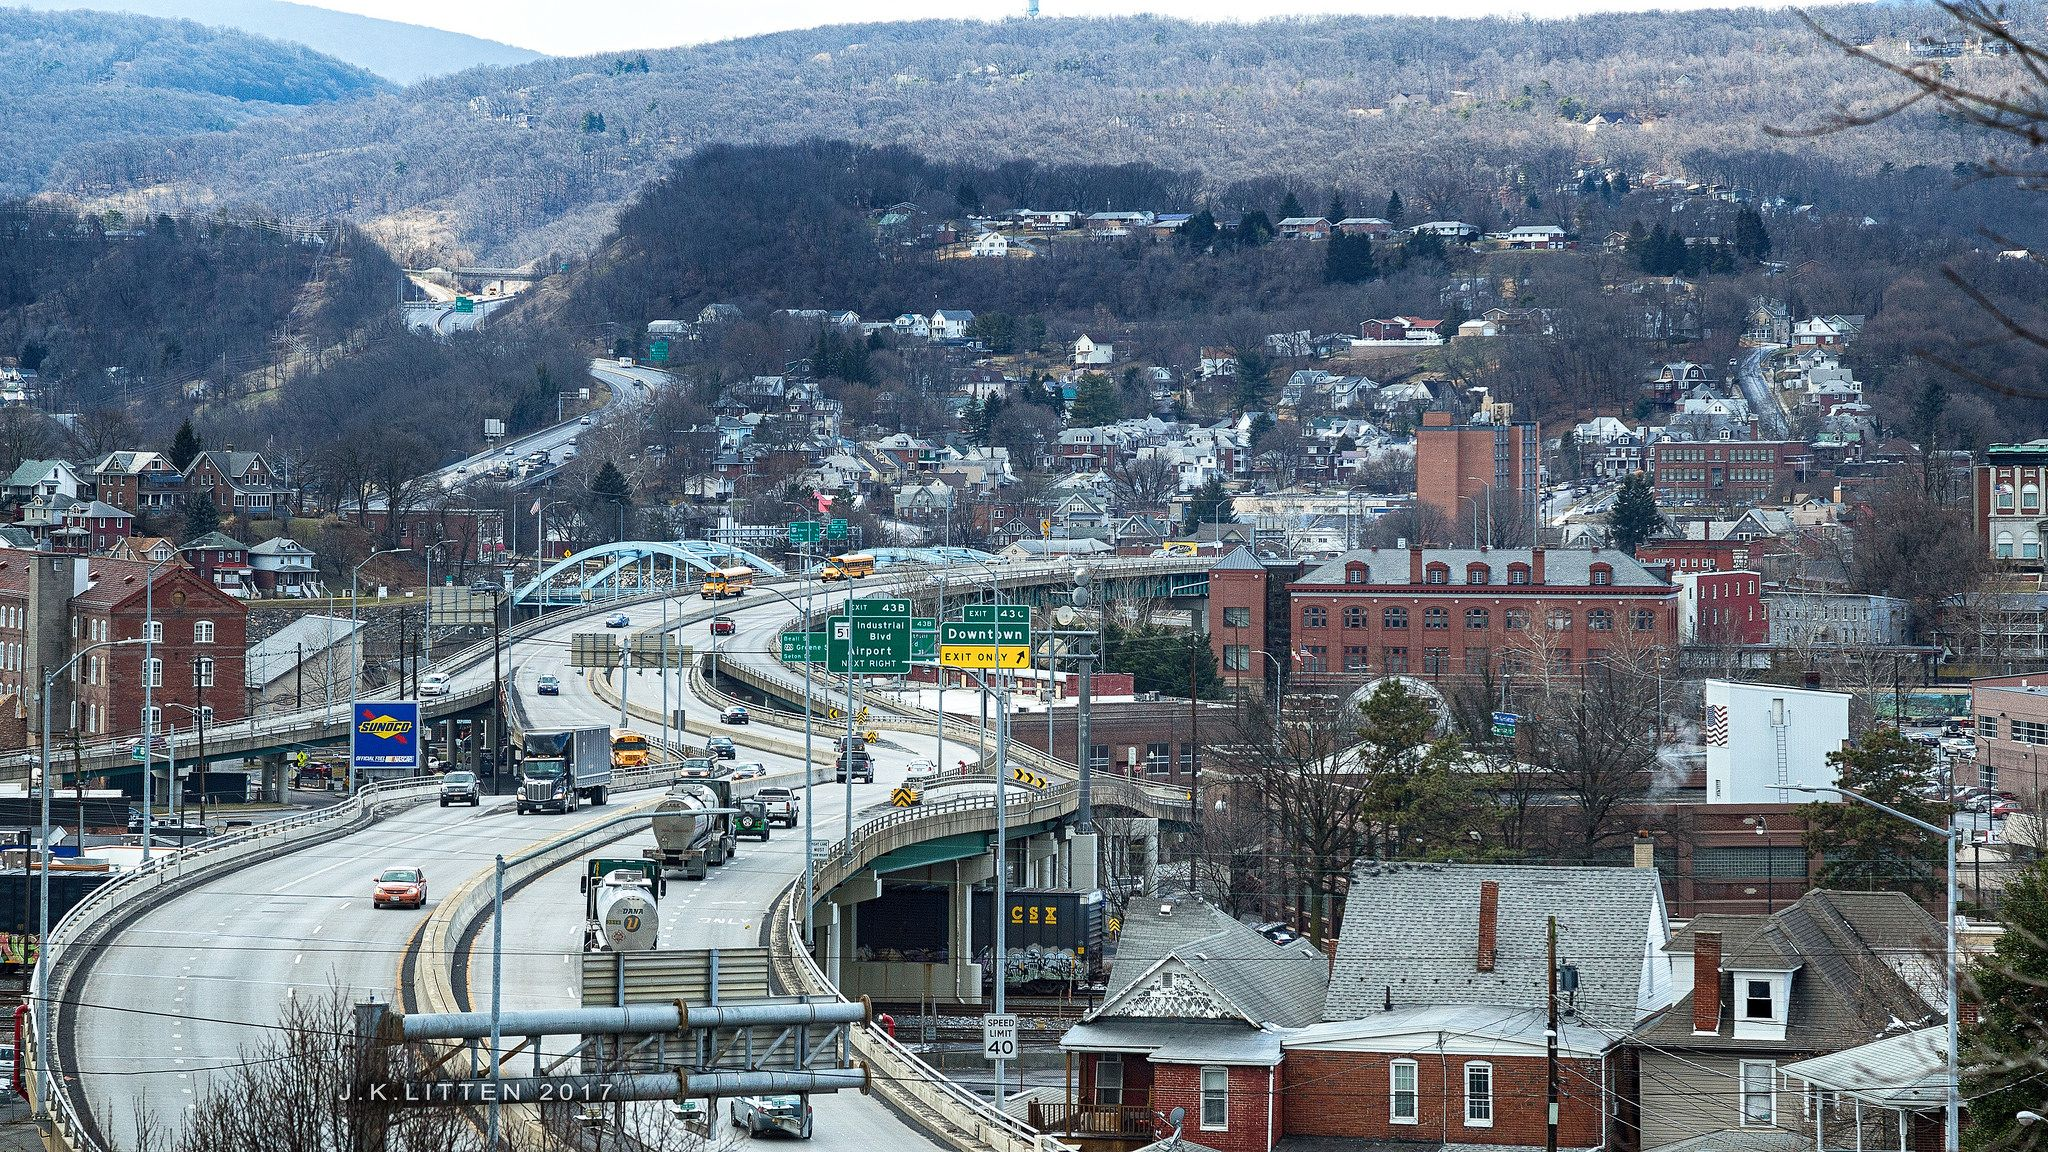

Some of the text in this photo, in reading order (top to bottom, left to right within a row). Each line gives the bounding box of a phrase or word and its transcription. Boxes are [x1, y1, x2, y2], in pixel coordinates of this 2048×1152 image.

[882, 603, 905, 612] 43B
[1000, 610, 1024, 618] 43C
[837, 621, 904, 638] 51 Industrial
[948, 628, 1022, 639] Downtown
[847, 646, 892, 656] Airport
[945, 652, 1008, 661] EXIT ONLY
[360, 722, 411, 732] SUNOCO
[1012, 906, 1057, 922] CSX
[987, 1019, 1015, 1027] SPEED
[989, 1029, 1013, 1038] LIMIT
[987, 1040, 1014, 1055] 40
